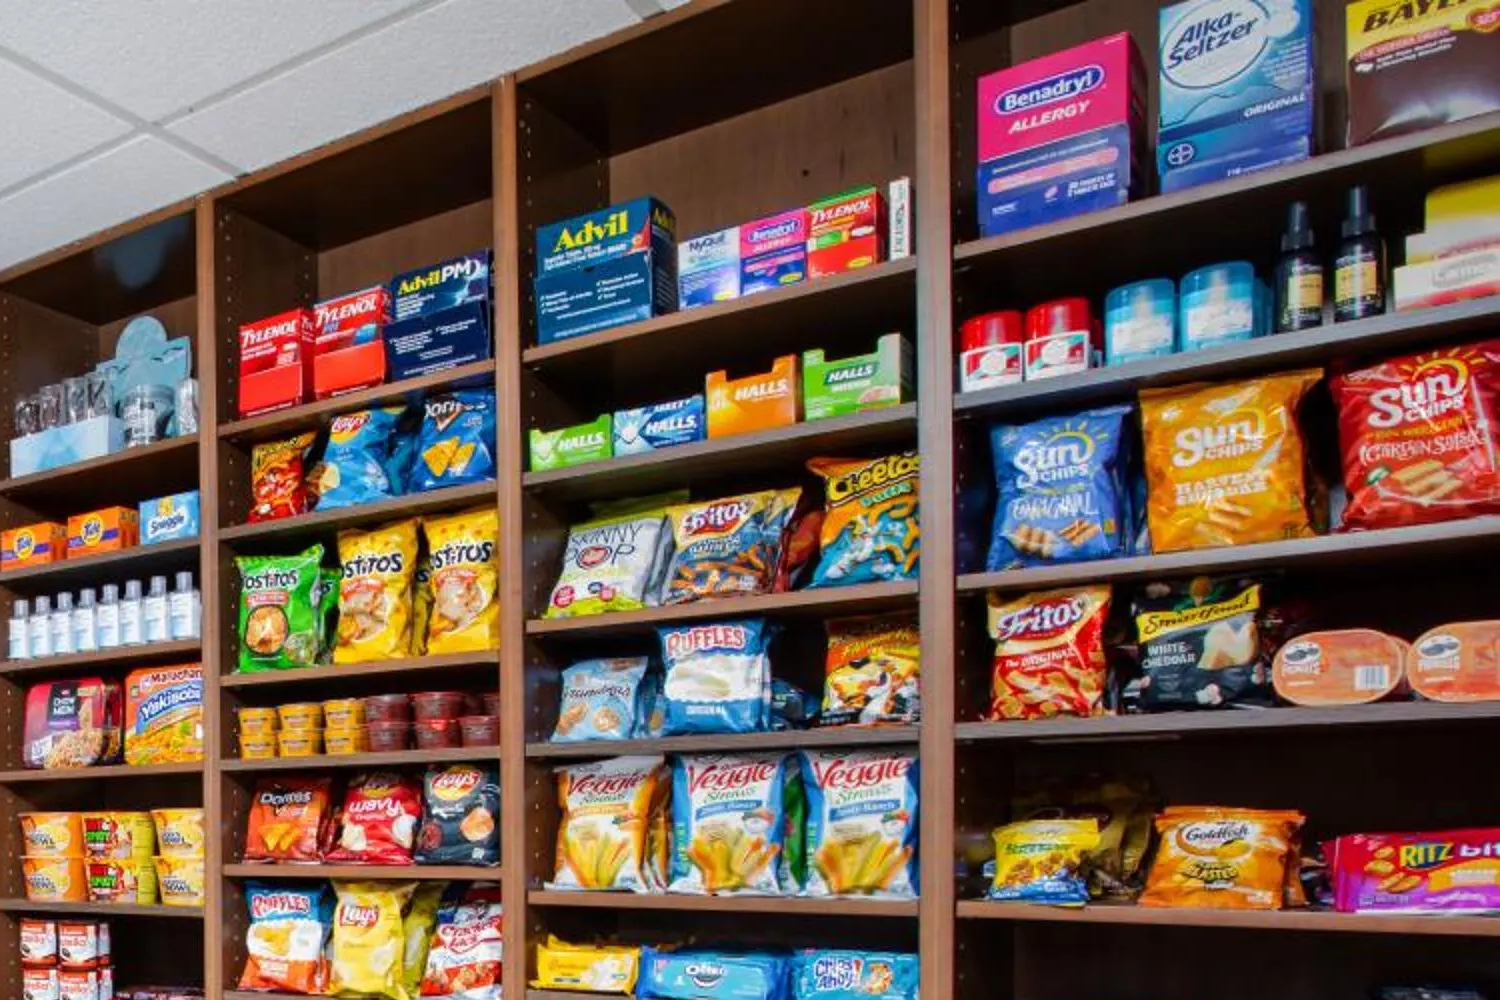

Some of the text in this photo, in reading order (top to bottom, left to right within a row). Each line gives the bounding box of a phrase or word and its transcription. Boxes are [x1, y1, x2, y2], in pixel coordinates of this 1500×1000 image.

[1173, 11, 1242, 50] Alka-
[1363, 0, 1469, 33] BAY
[1167, 17, 1258, 69] Seltzer
[1004, 70, 1095, 111] Benadryl
[1008, 101, 1091, 135] ALLERGY
[1243, 93, 1306, 119] ORIGINAL
[812, 198, 872, 226] TYLENOL
[553, 209, 629, 253] Advil
[399, 261, 472, 295] Advil PM
[315, 296, 378, 328] TYLENOL
[241, 319, 297, 348] TYLENOL
[827, 363, 875, 384] HALLS
[735, 379, 790, 401] HALLS
[1367, 373, 1468, 428] Sun
[1402, 392, 1465, 422] CHIPS
[645, 415, 697, 436] HALLS
[558, 430, 605, 452] HALLS
[1173, 418, 1268, 468] Sun
[1202, 438, 1264, 461] CHIPS
[1014, 440, 1090, 488] Sun
[1040, 461, 1089, 480] CHIPS
[681, 500, 751, 532] Fritos
[570, 523, 643, 545] SKINNY
[996, 598, 1086, 641] Fritos
[1143, 592, 1252, 636] Smartfood
[665, 625, 746, 658] RUFFLES
[1146, 641, 1186, 656] WHITE
[1142, 652, 1197, 670] CHEDDAR
[568, 770, 646, 800] Veggie
[687, 757, 778, 795] Veggie
[815, 755, 912, 795] Veggie
[1185, 822, 1250, 843] Goldfish
[1400, 841, 1500, 868] RITZ bit
[251, 894, 310, 917] RUFFLES
[340, 904, 380, 926] Lay's
